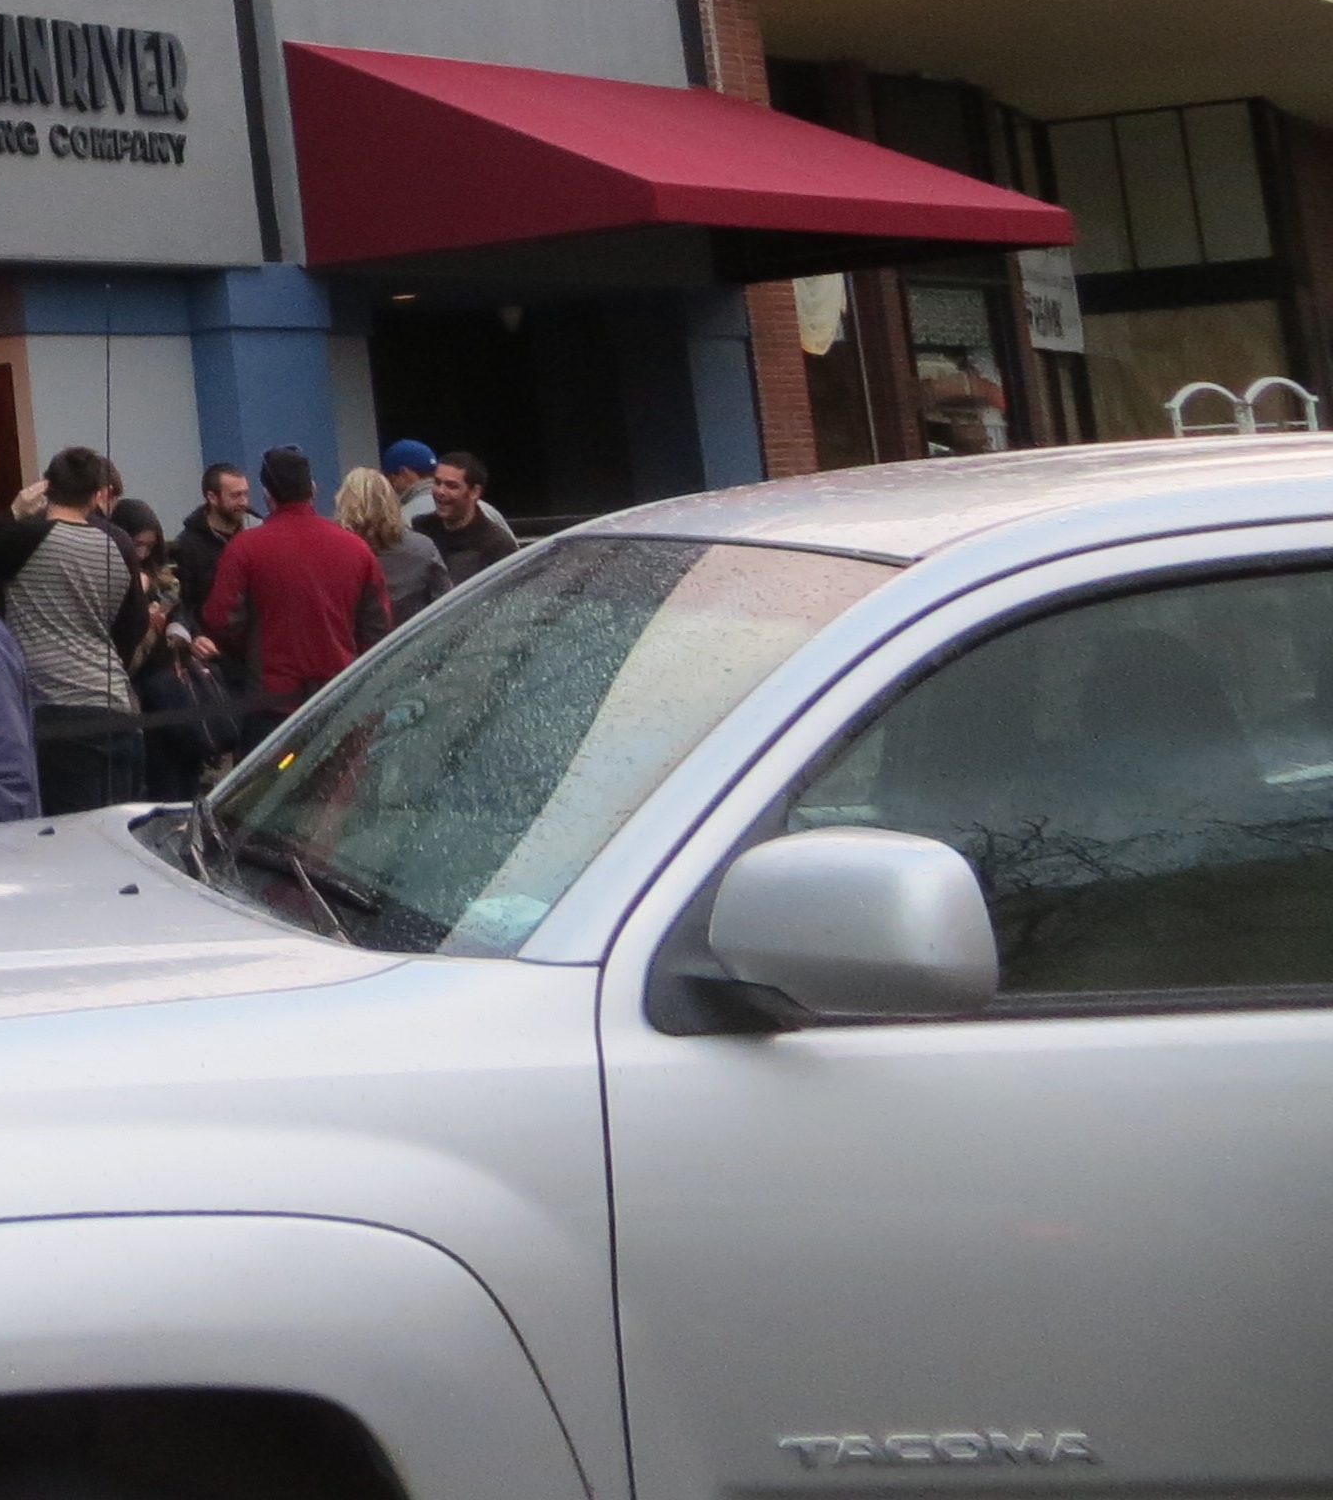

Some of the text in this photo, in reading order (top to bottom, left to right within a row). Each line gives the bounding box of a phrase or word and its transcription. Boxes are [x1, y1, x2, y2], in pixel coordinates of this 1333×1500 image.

[51, 17, 189, 121] RIVER
[48, 123, 189, 165] COMPANY
[778, 1431, 1103, 1470] TACOMA
